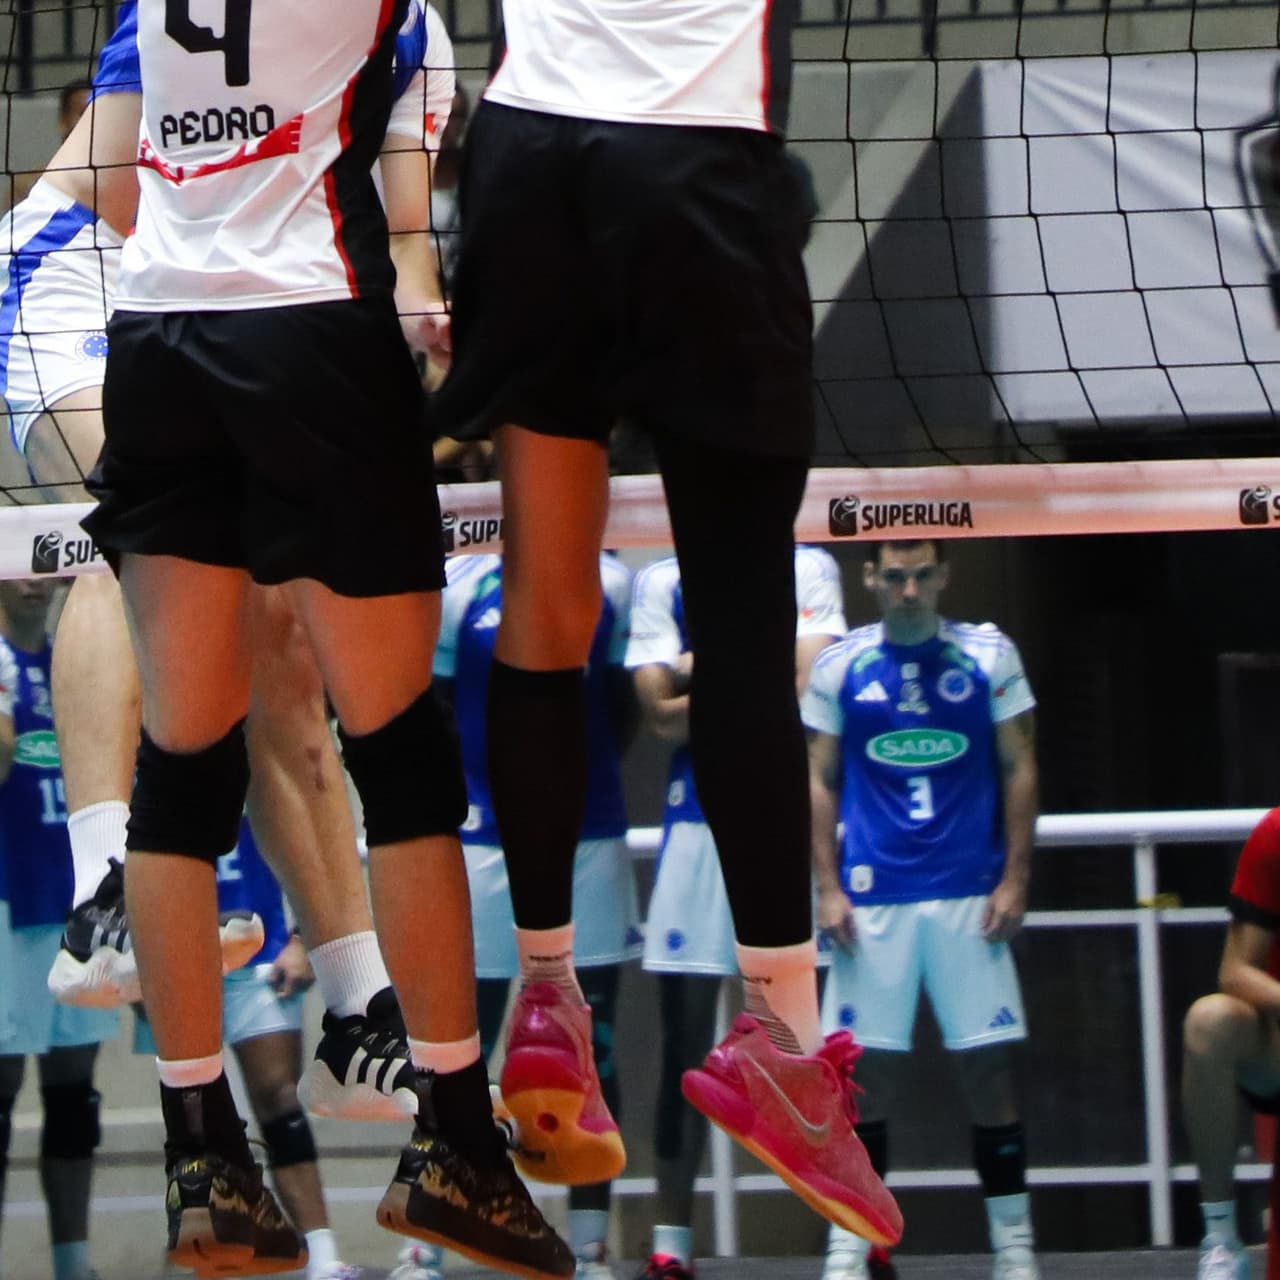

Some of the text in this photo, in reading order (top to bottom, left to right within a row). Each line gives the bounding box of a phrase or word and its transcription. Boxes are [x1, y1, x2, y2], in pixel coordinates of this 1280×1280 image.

[160, 103, 276, 149] PEDRO
[860, 500, 973, 532] SUPERLIGA
[880, 738, 956, 758] SADA
[906, 776, 935, 820] 3
